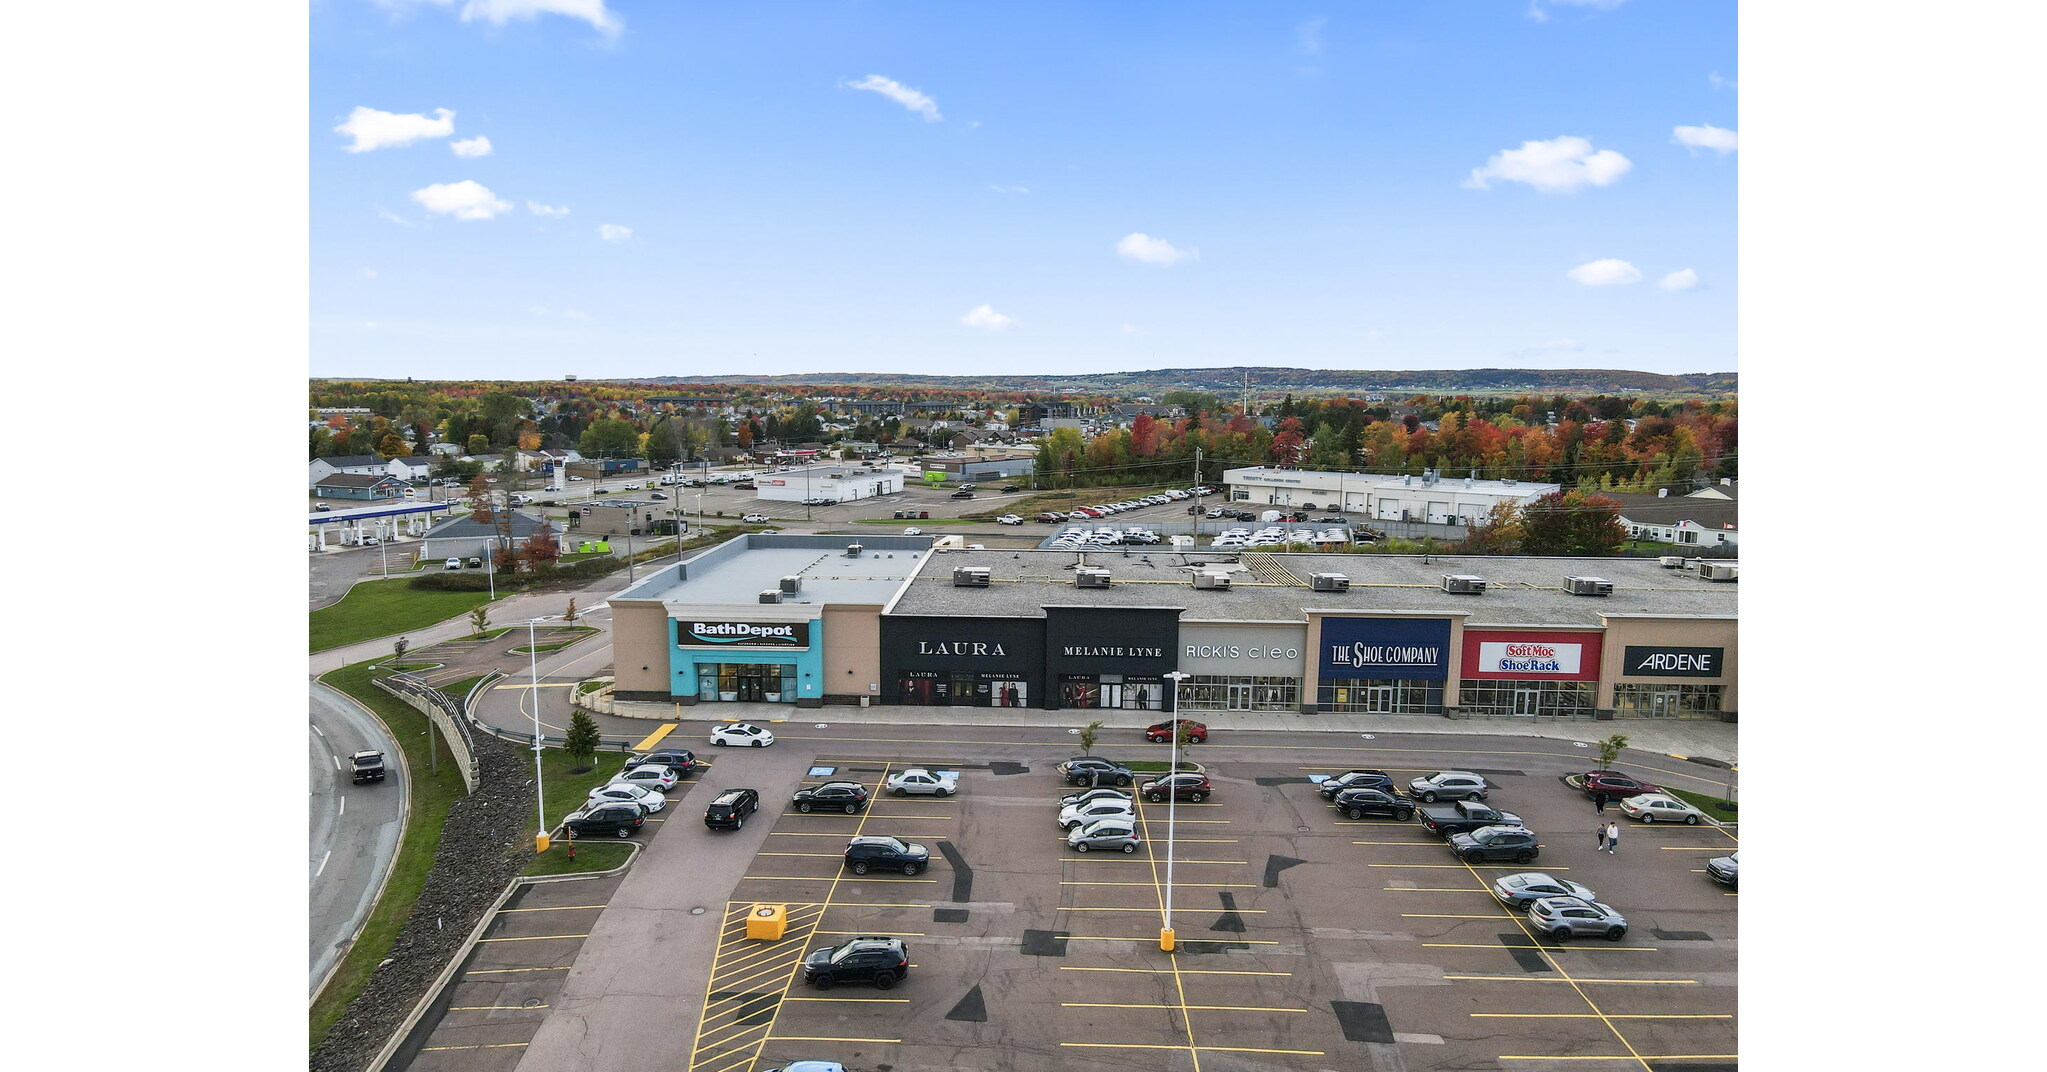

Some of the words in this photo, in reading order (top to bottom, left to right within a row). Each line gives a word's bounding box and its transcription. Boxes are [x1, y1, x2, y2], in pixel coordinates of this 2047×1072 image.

[919, 641, 1006, 656] LAURA
[1064, 646, 1124, 656] MELANIE
[1129, 647, 1162, 657] LYNE
[1186, 645, 1240, 658] RICKI'S
[1248, 645, 1298, 659] cleo
[1332, 645, 1351, 662] THE
[1386, 646, 1439, 663] COMPANY
[1637, 653, 1711, 671] ARDENE
